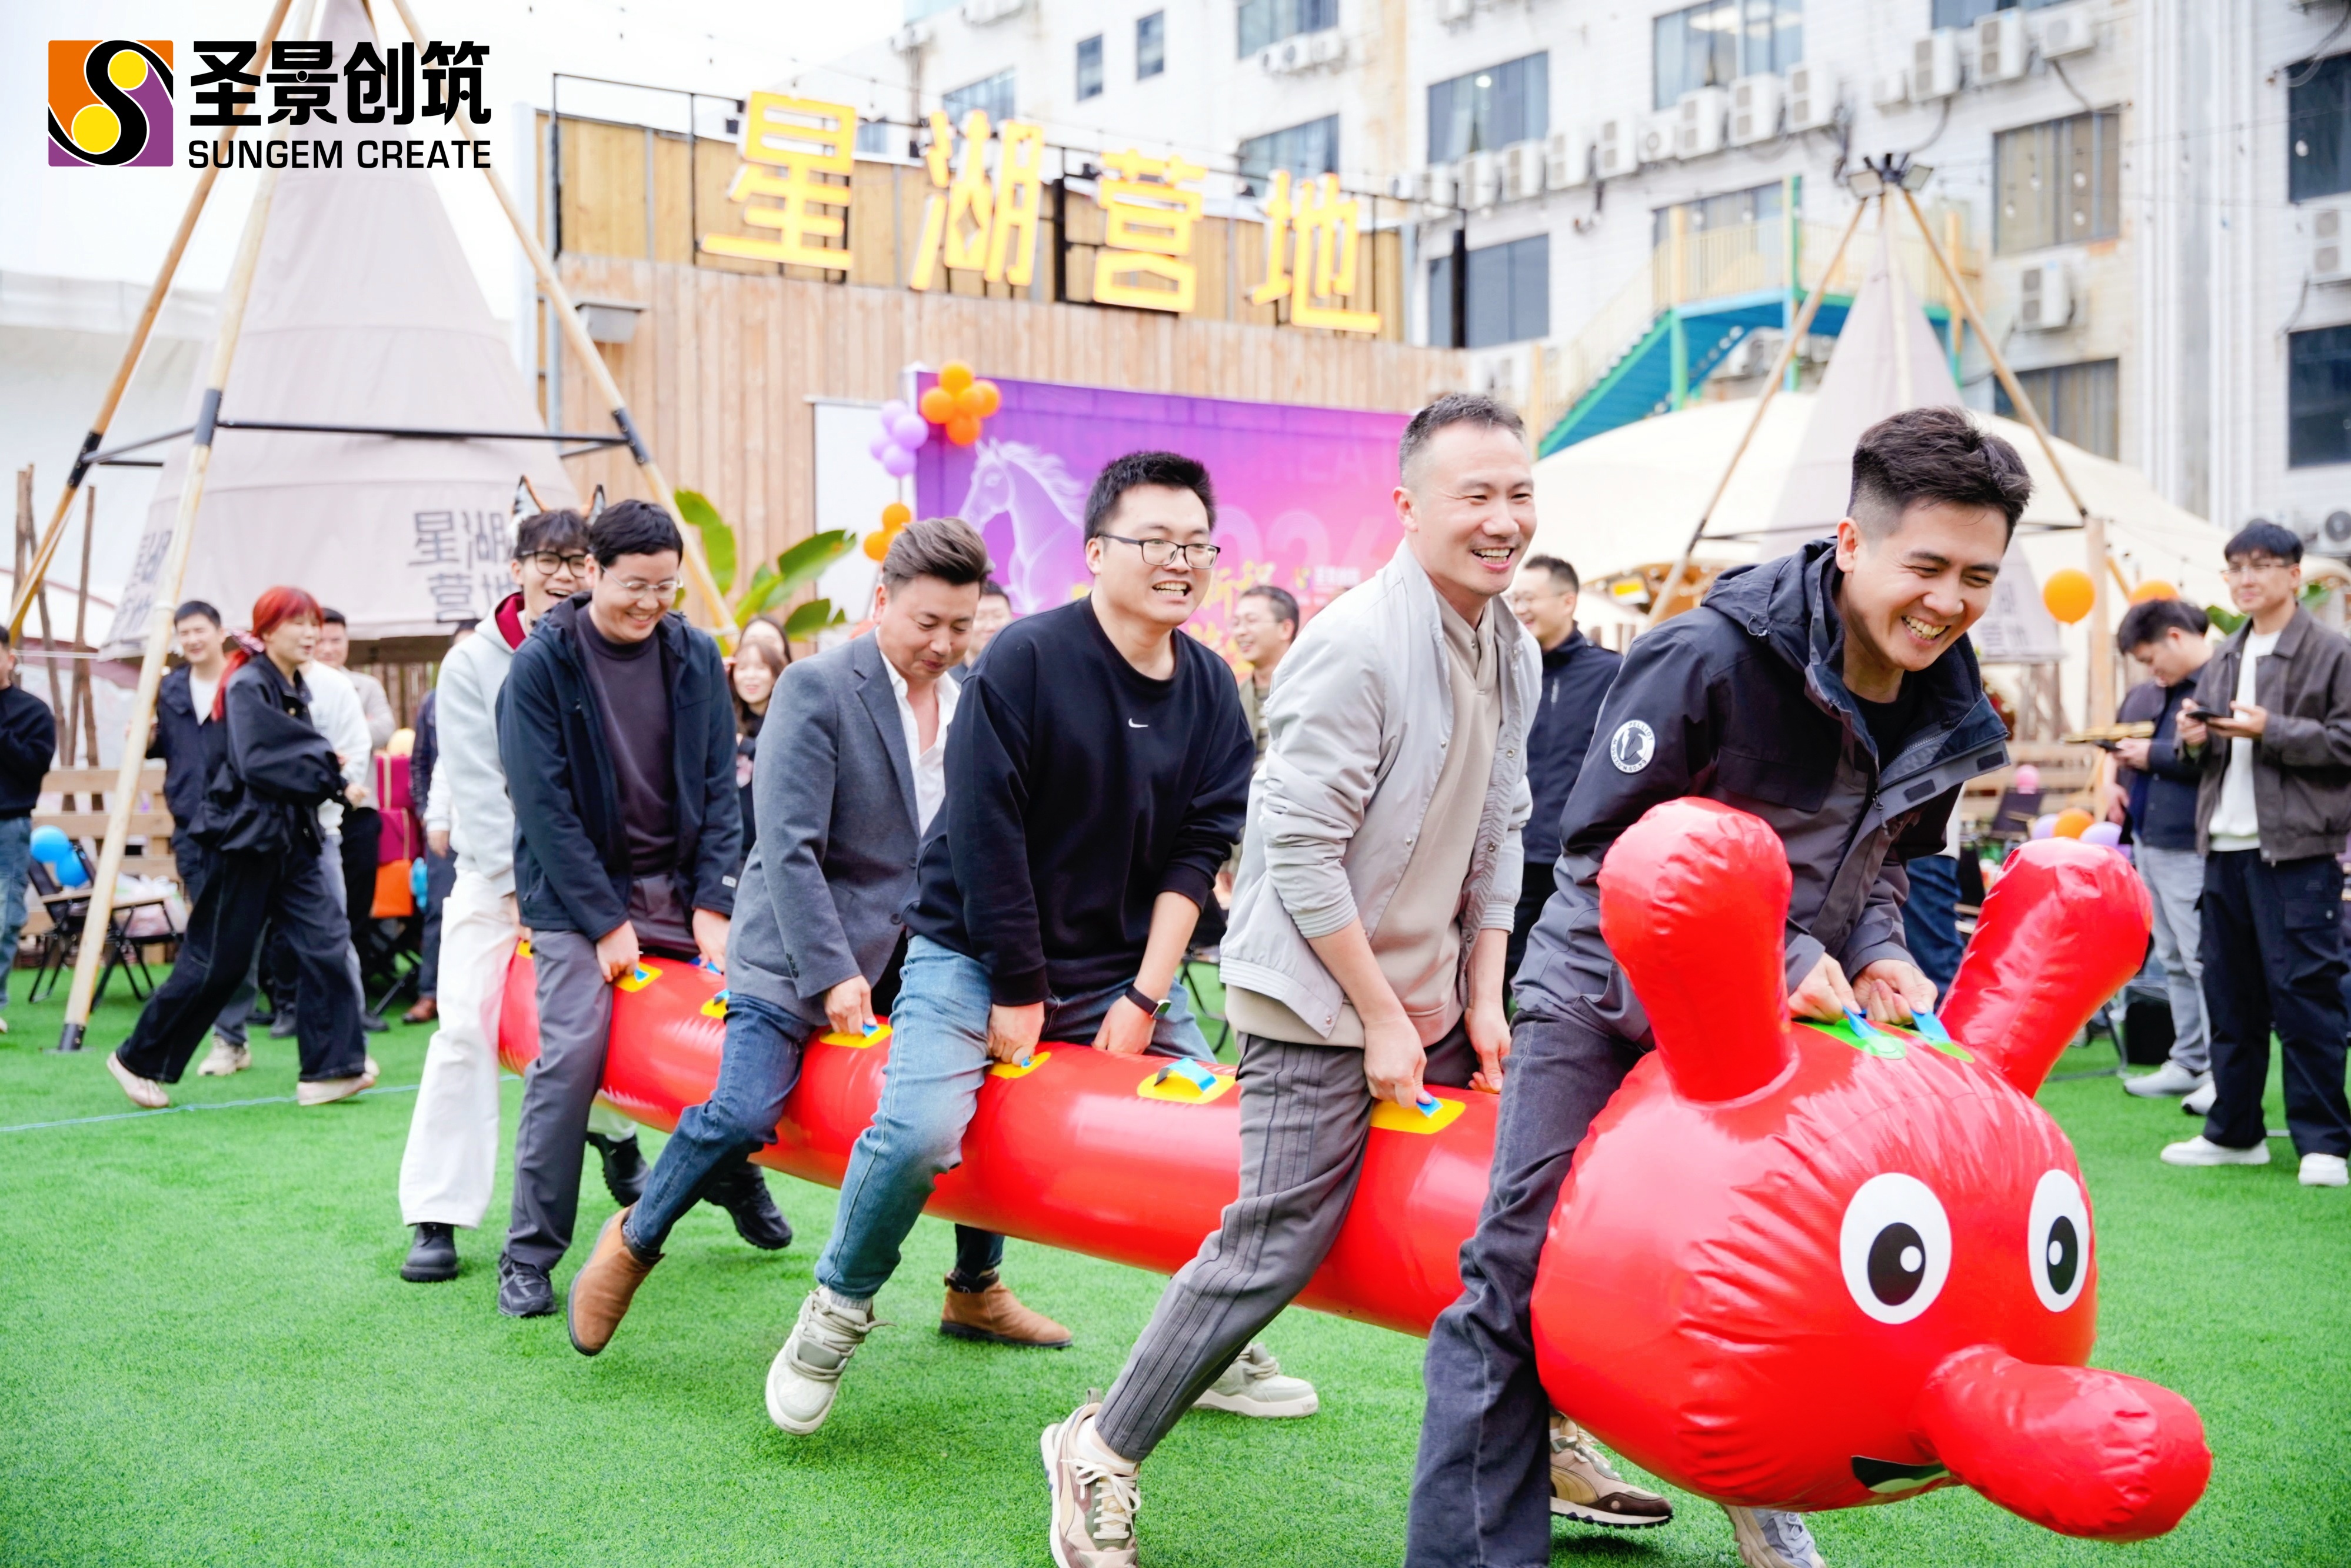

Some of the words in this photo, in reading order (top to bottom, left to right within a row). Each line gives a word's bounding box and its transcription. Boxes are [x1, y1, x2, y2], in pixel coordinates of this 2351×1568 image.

[700, 90, 1382, 333] 星湖营地
[1629, 721, 1653, 740] PELLIOT
